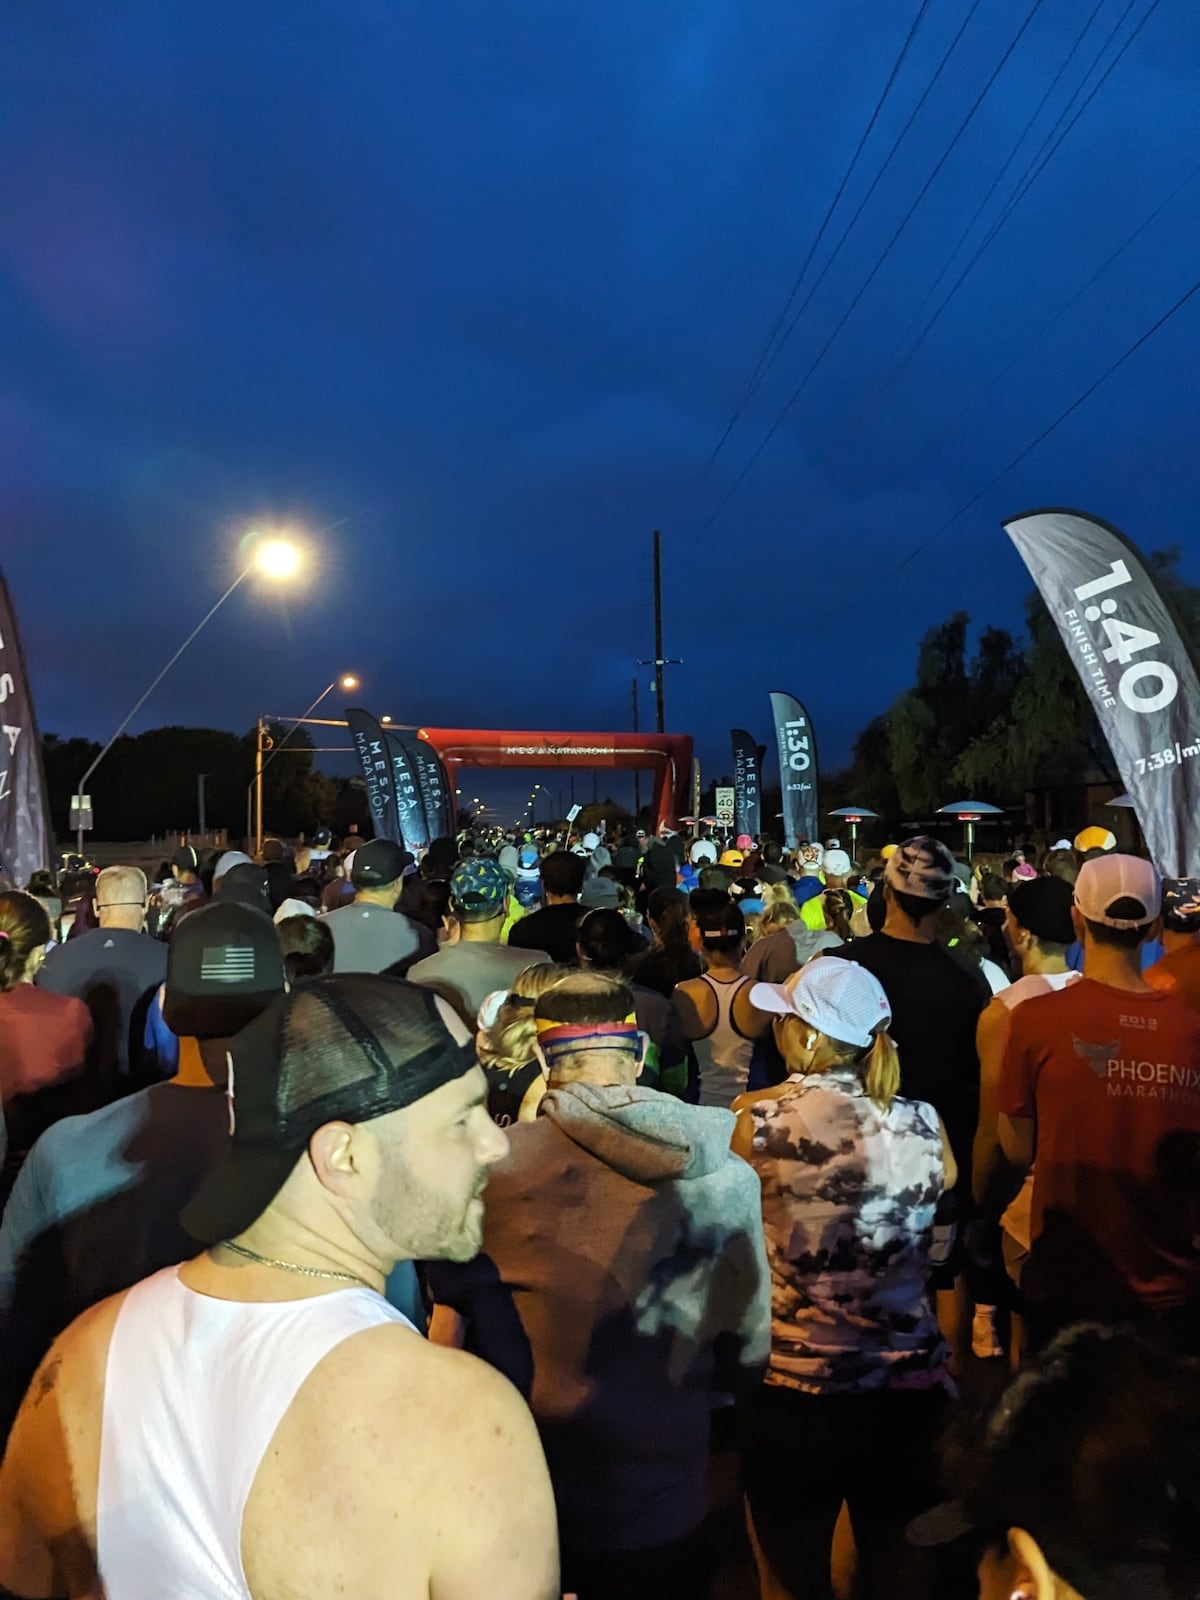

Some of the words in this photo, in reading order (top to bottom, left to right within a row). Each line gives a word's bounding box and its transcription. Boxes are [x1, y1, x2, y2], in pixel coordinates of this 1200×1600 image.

[1065, 609, 1098, 667] FINISH
[1092, 667, 1117, 708] TIME
[1074, 559, 1178, 713] 1:40
[369, 741, 390, 804] MESA
[785, 717, 810, 771] 1:30
[355, 732, 385, 819] MARATHON
[393, 756, 418, 808] MESA
[415, 756, 434, 818] MARATHON
[426, 763, 441, 809] MESA
[718, 799, 733, 807] 40
[735, 749, 745, 818] MARATHON
[745, 758, 756, 809] MESA
